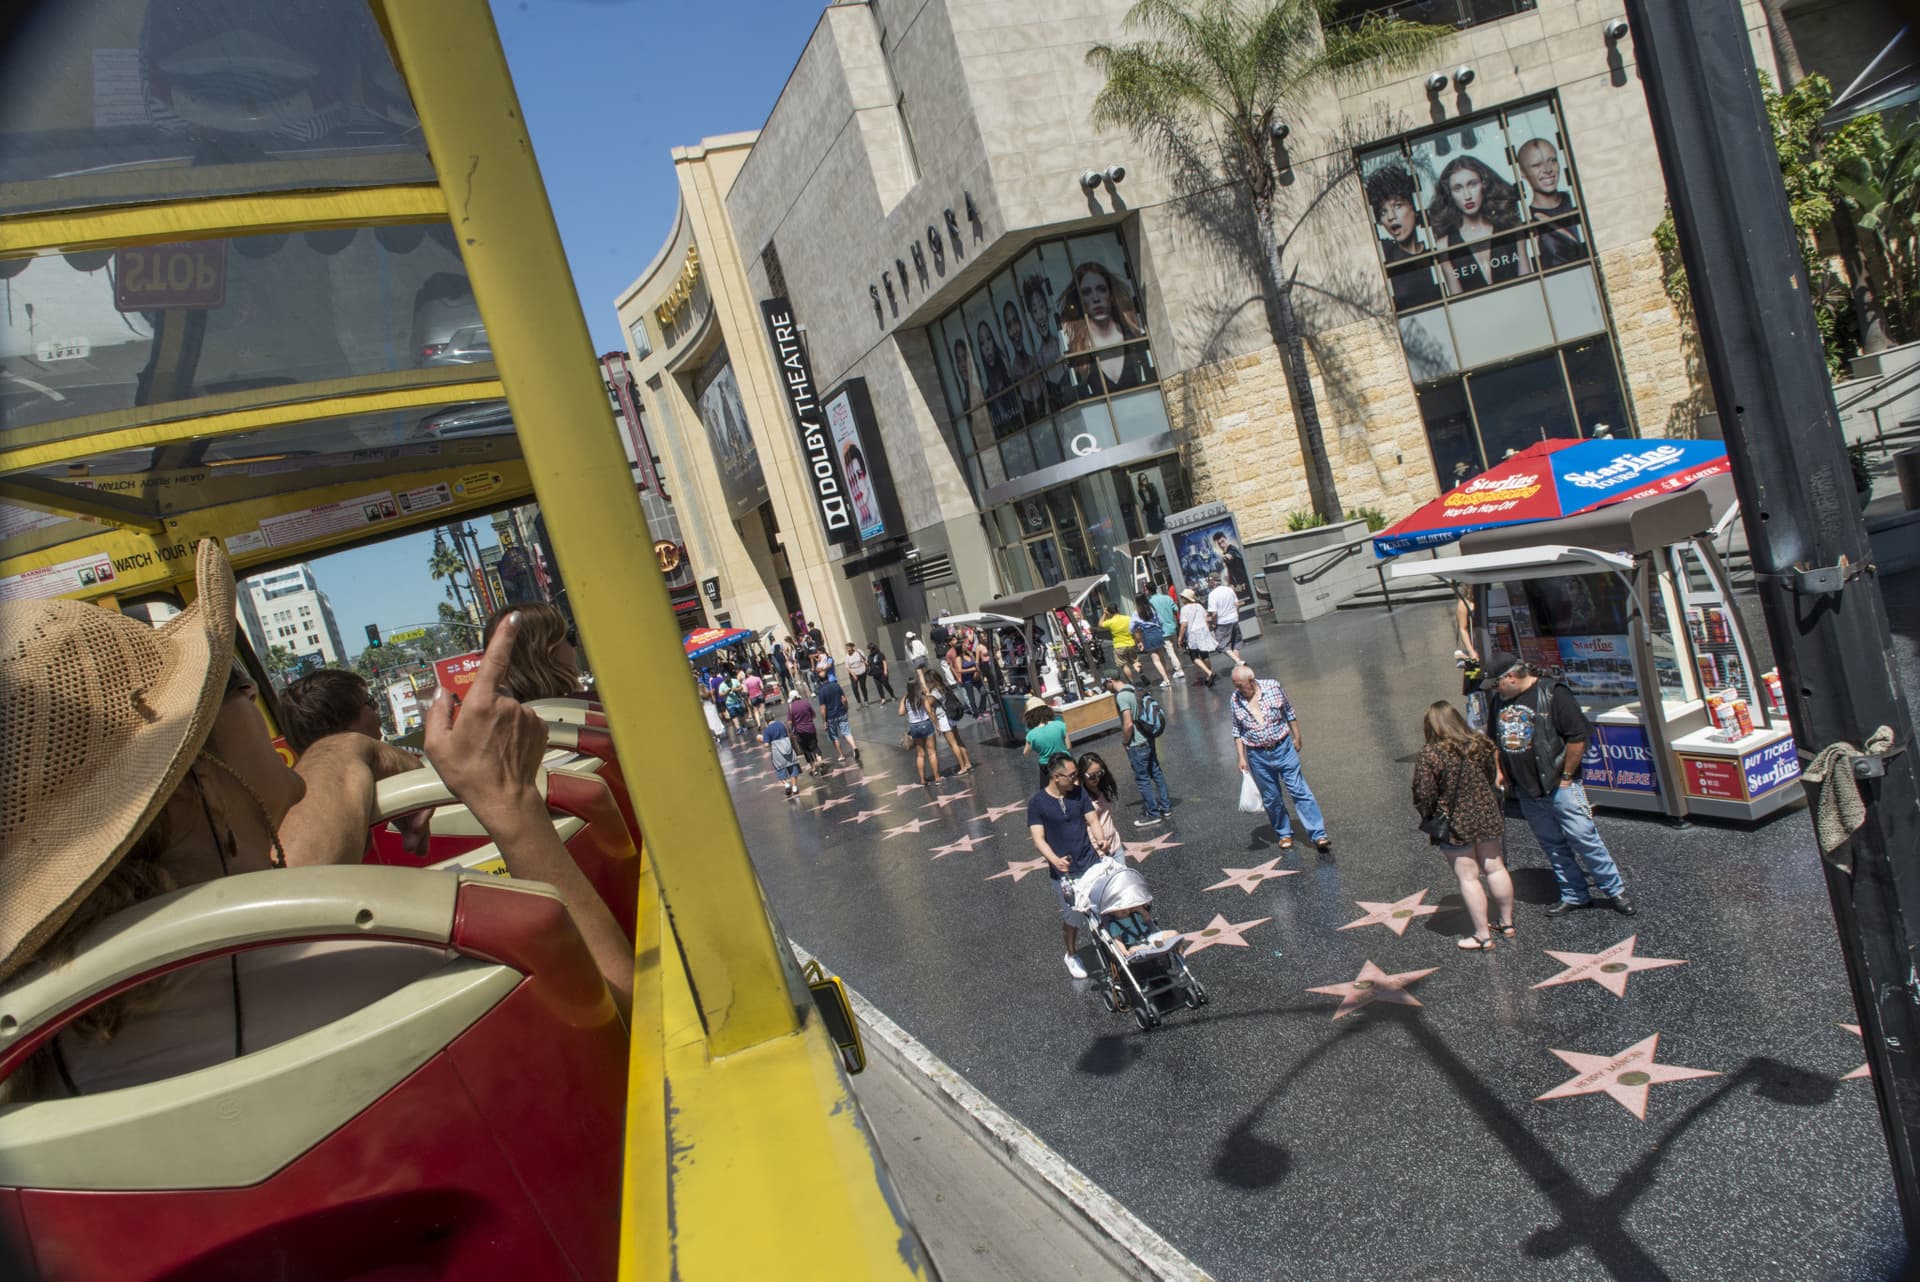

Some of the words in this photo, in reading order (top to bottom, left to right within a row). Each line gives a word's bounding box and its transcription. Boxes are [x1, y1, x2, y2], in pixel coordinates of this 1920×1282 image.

[869, 190, 979, 308] SEPHORA
[771, 311, 815, 417] THEATRE
[801, 422, 838, 496] DOLBY
[1071, 433, 1102, 457] Q
[1564, 444, 1685, 487] Starline
[1592, 471, 1641, 490] TOURS
[1465, 473, 1538, 494] Starline
[1166, 504, 1229, 528] DIRECTORY
[113, 552, 153, 573] WATCH
[154, 542, 187, 562] YOUR
[1572, 638, 1614, 652] Starline
[1599, 744, 1653, 760] TOURS
[1744, 752, 1761, 770] BUY
[1764, 738, 1795, 760] TICKET
[1748, 757, 1801, 792] Starline
